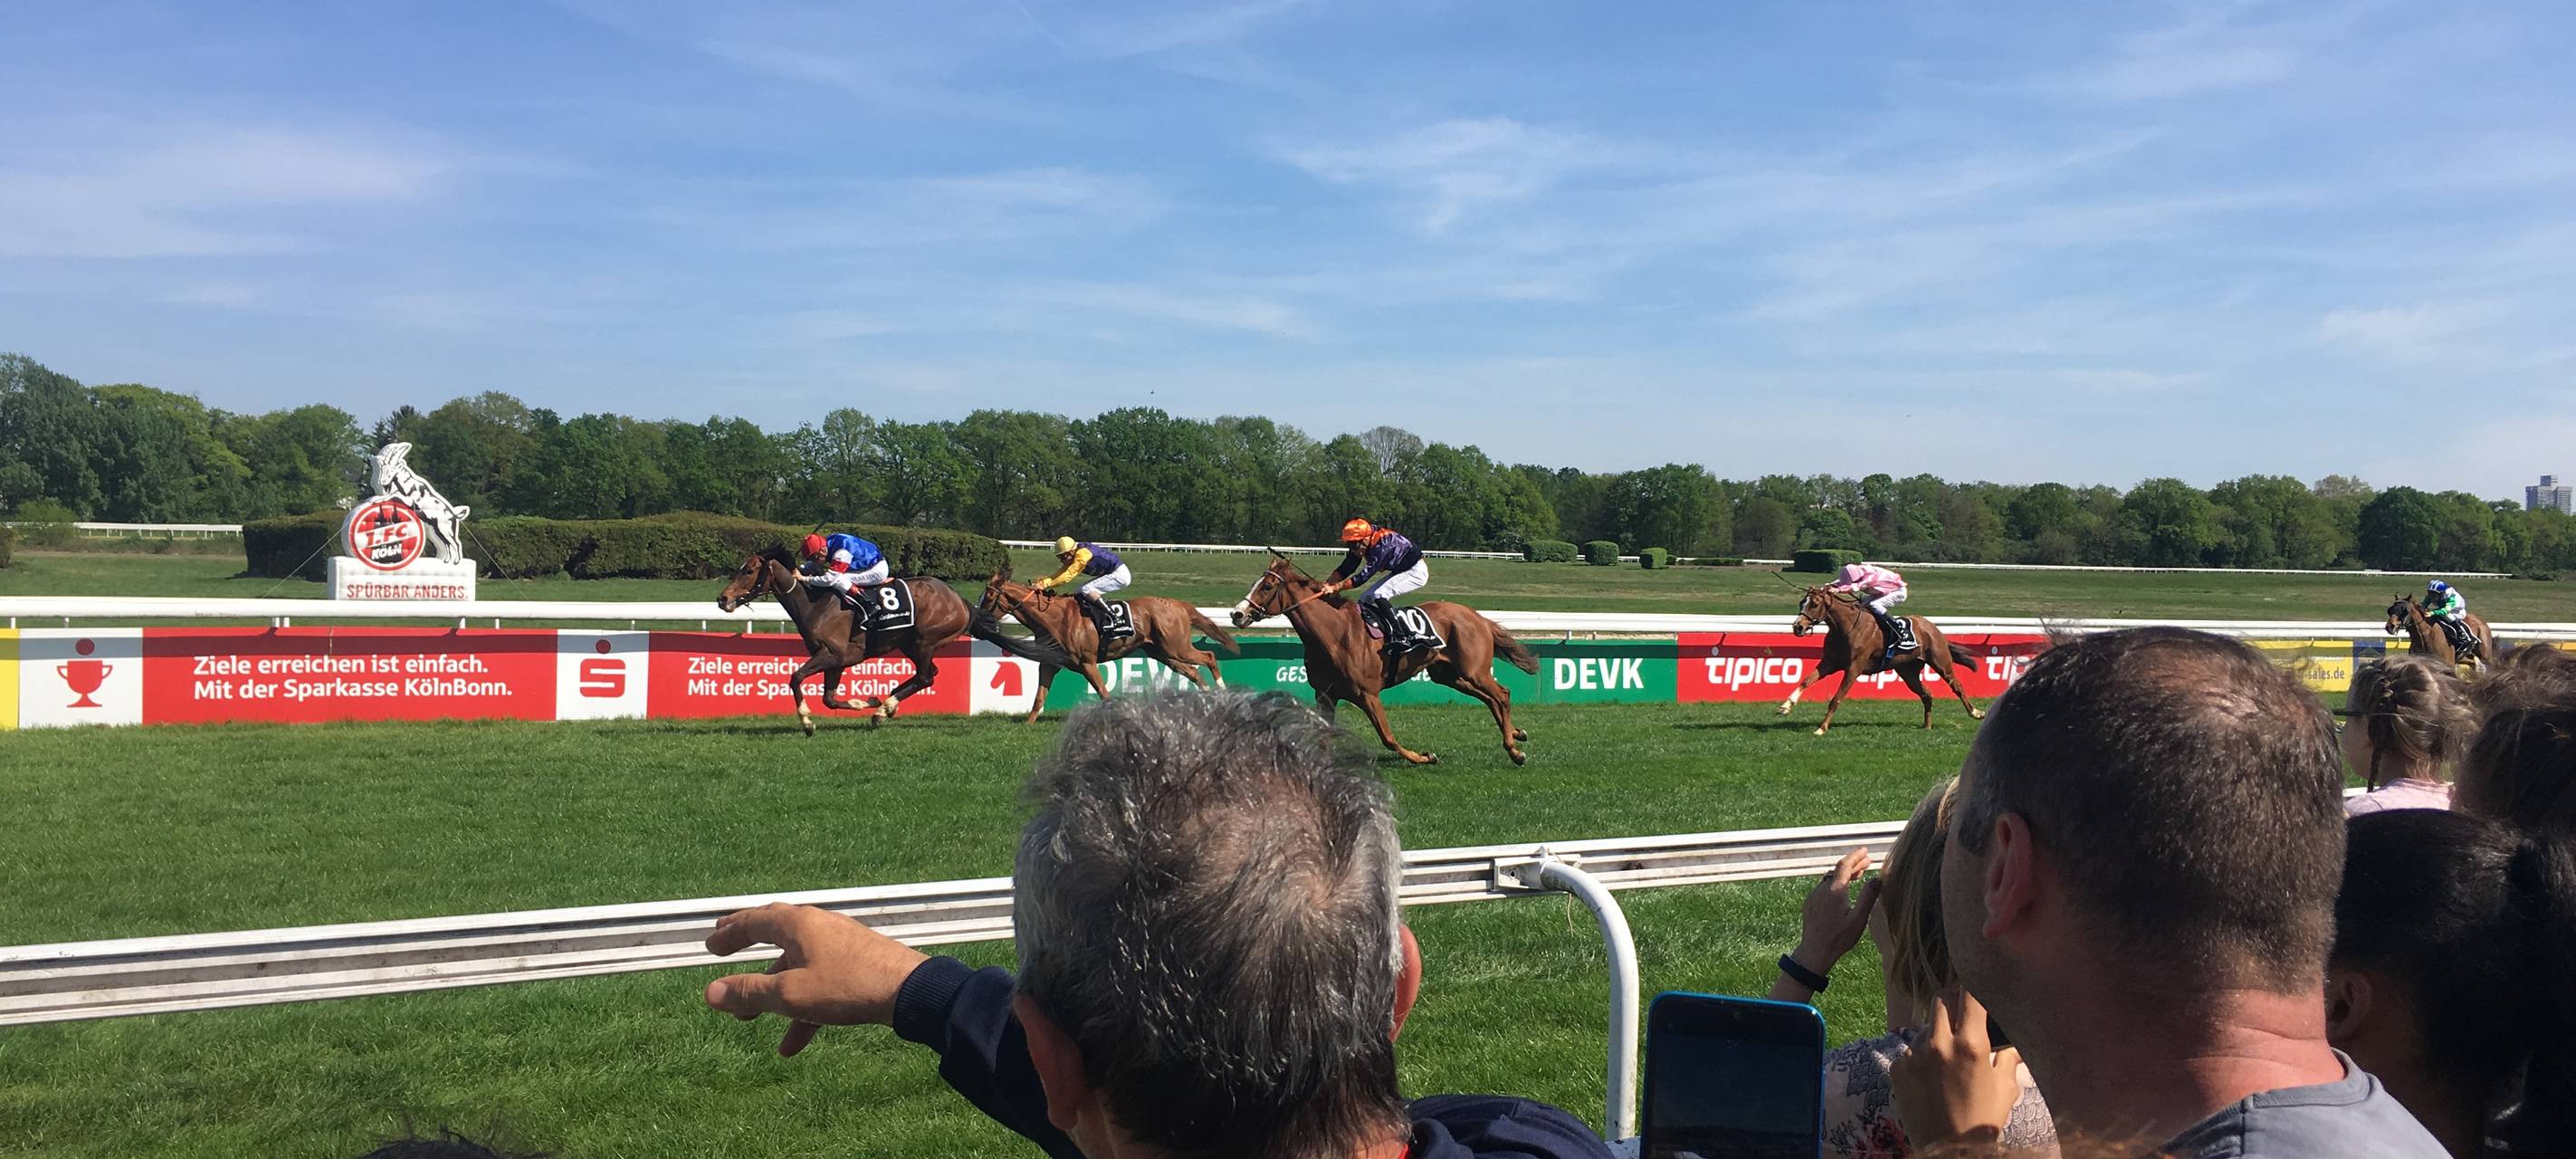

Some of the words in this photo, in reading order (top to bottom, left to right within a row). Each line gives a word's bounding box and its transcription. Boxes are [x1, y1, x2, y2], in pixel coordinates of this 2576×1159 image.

[371, 545, 402, 560] KÖLN
[347, 581, 407, 599] SPÜRBAR
[414, 585, 468, 599] ANDERS.
[880, 587, 900, 610] 8
[1396, 609, 1426, 635] 10
[194, 655, 252, 675] Ziele
[258, 655, 365, 674] erreichen
[371, 654, 400, 673] ist
[405, 654, 489, 673] einfach.
[688, 656, 732, 675] Ziele
[738, 657, 806, 675] erreich
[851, 658, 917, 675] einfach.
[1554, 658, 1645, 689] DEVK
[1705, 657, 1803, 691] tipico
[194, 679, 233, 699] Mit
[239, 679, 278, 698] der
[283, 677, 398, 702] Sparkasse
[405, 677, 512, 696] KölnBonn.
[688, 678, 718, 695] Mit
[723, 678, 753, 695] der
